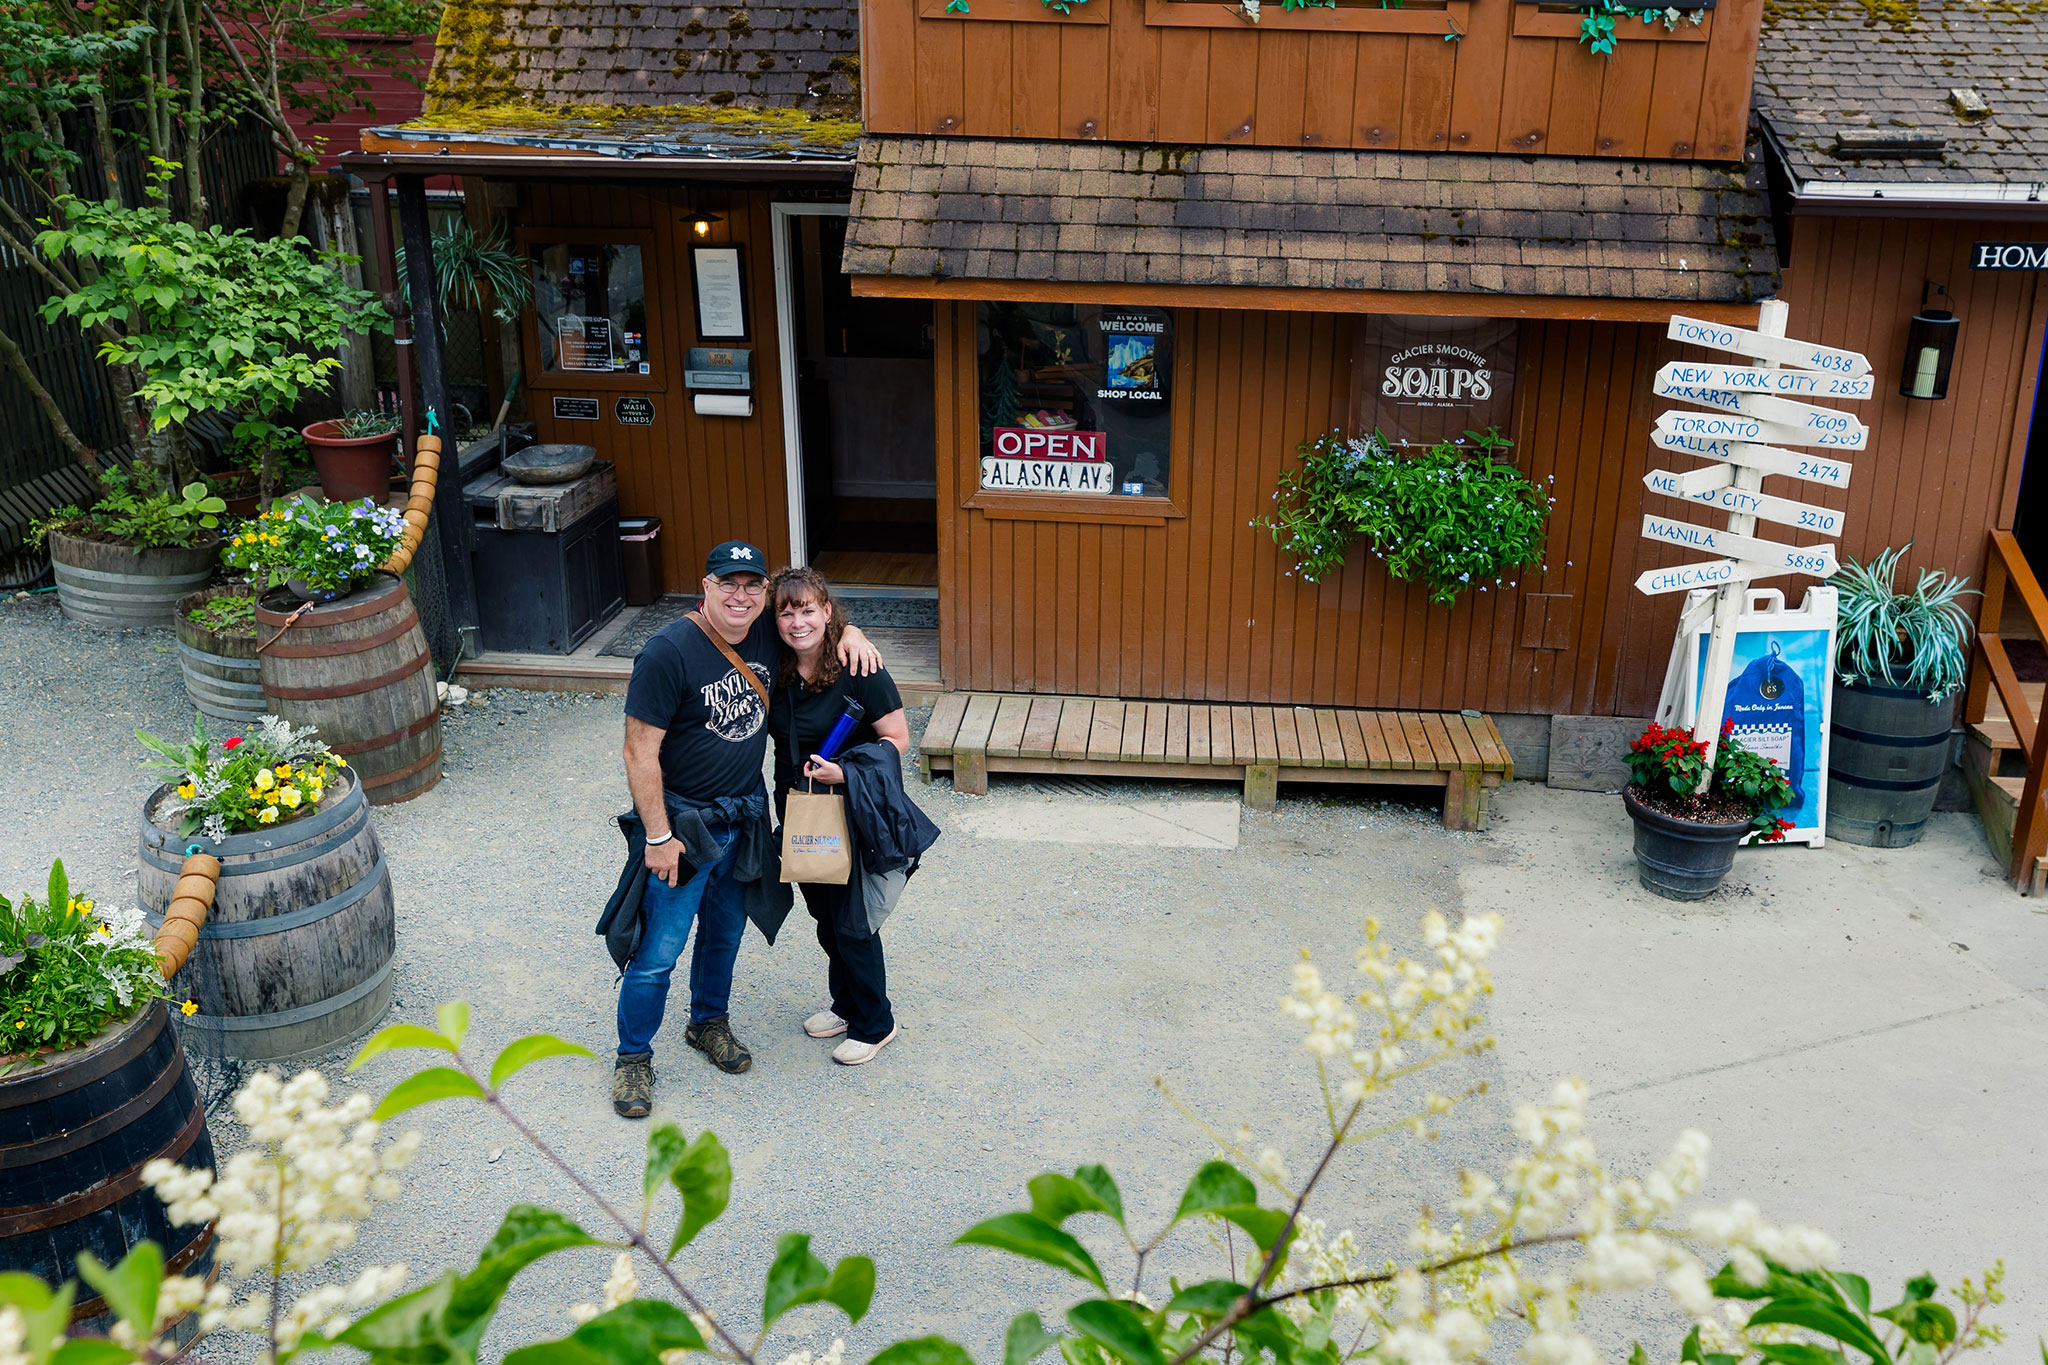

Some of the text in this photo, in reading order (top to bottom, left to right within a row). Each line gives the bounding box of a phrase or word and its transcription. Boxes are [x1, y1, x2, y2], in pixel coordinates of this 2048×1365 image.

[1977, 246, 2048, 268] HOM
[1100, 321, 1164, 333] WELCOME
[1391, 344, 1487, 368] GLACIER SMOOTHIE
[1677, 323, 1853, 373] TOKYO 4038
[1381, 366, 1492, 400] SOAPS
[1671, 367, 1870, 395] NEW YORK CITY 2852
[1097, 389, 1162, 400] SHOP LOCAL
[1661, 385, 1848, 433] JAKARTA 7609
[1672, 417, 1760, 438] TORONTO
[997, 432, 1096, 459] OPEN
[1664, 434, 1840, 481] DALLAS 2474
[991, 462, 1070, 488] ALASKA
[1652, 475, 1835, 529] MEO CITY 3210
[730, 547, 753, 560] M
[1648, 522, 1825, 572] MANILA 5889
[1651, 565, 1732, 590] CHICAGO
[1751, 703, 1765, 712] Only
[791, 835, 813, 845] GLACIER
